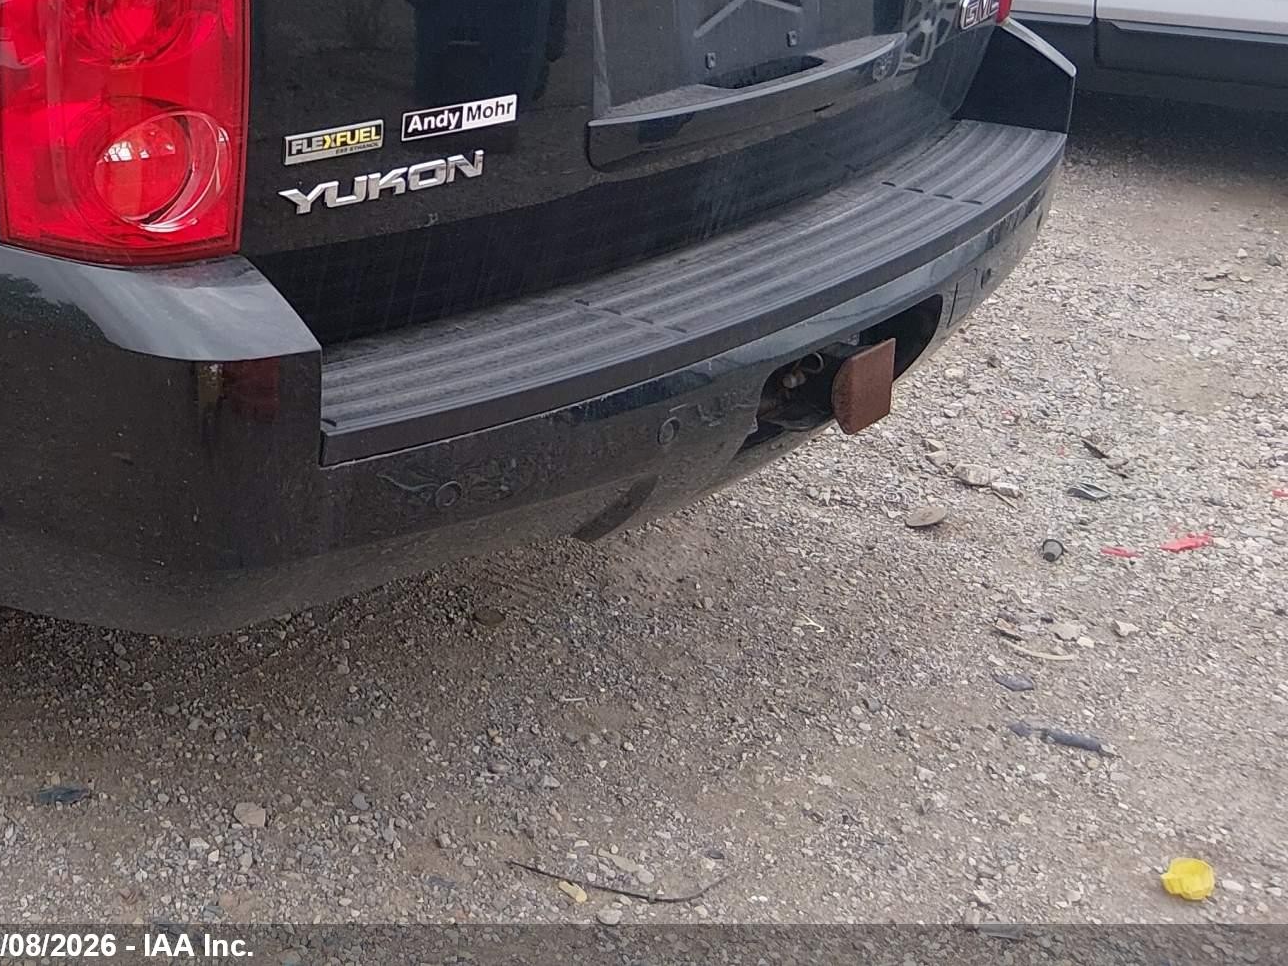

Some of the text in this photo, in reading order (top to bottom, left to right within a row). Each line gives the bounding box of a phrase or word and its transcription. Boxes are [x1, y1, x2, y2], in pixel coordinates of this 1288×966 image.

[407, 100, 514, 133] Andy Mohr
[278, 149, 485, 215] YUKON
